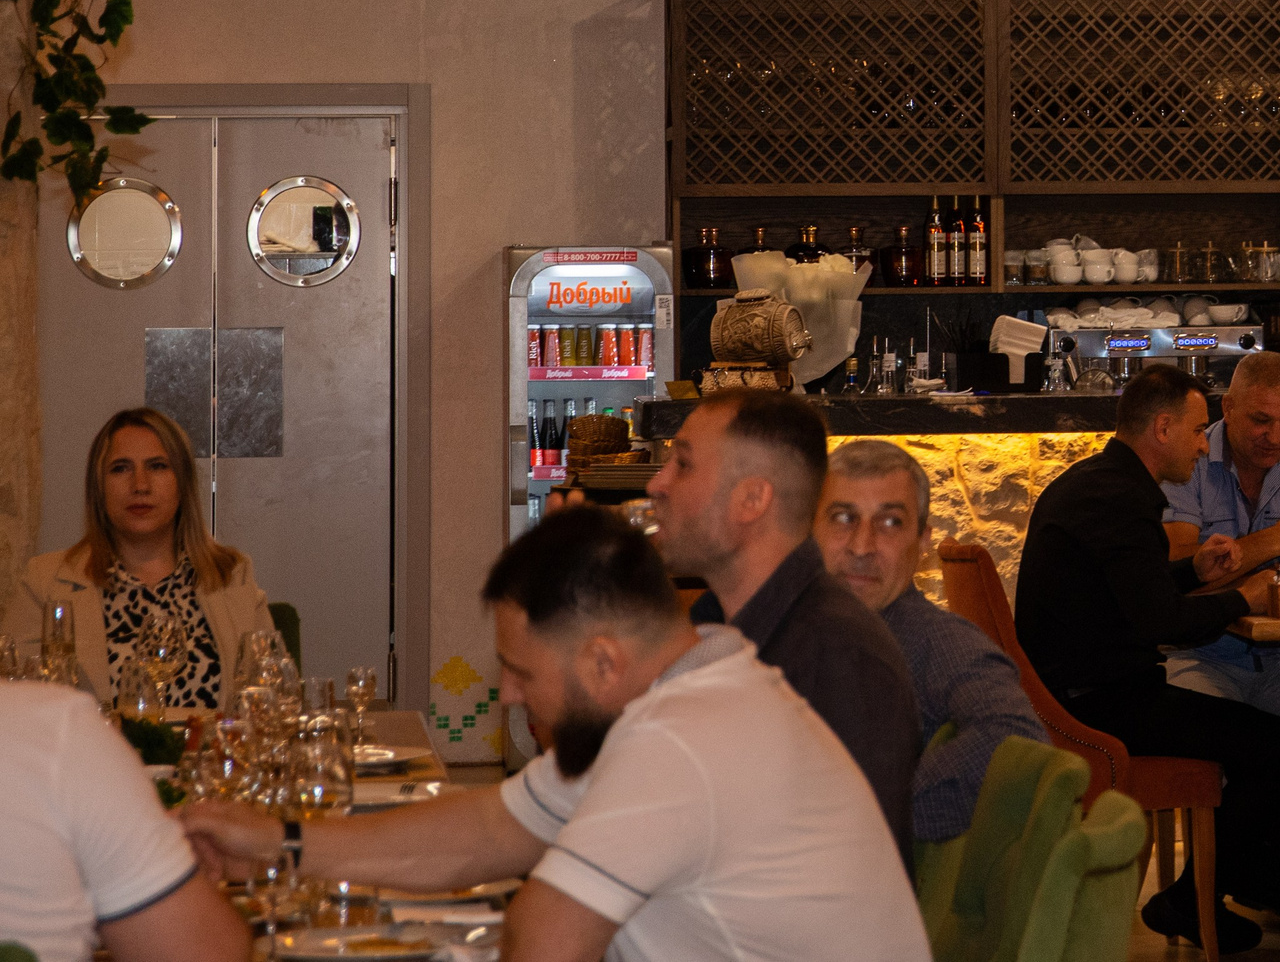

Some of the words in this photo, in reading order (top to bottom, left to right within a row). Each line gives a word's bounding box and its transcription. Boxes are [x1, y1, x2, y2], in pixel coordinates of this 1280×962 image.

[563, 253, 620, 261] 8-800-700-7777
[546, 280, 632, 309] Добрый
[529, 341, 538, 359] Rich
[563, 339, 572, 358] Rich
[579, 339, 589, 358] Rich
[546, 369, 573, 379] Добрый
[602, 368, 629, 378] Добрый
